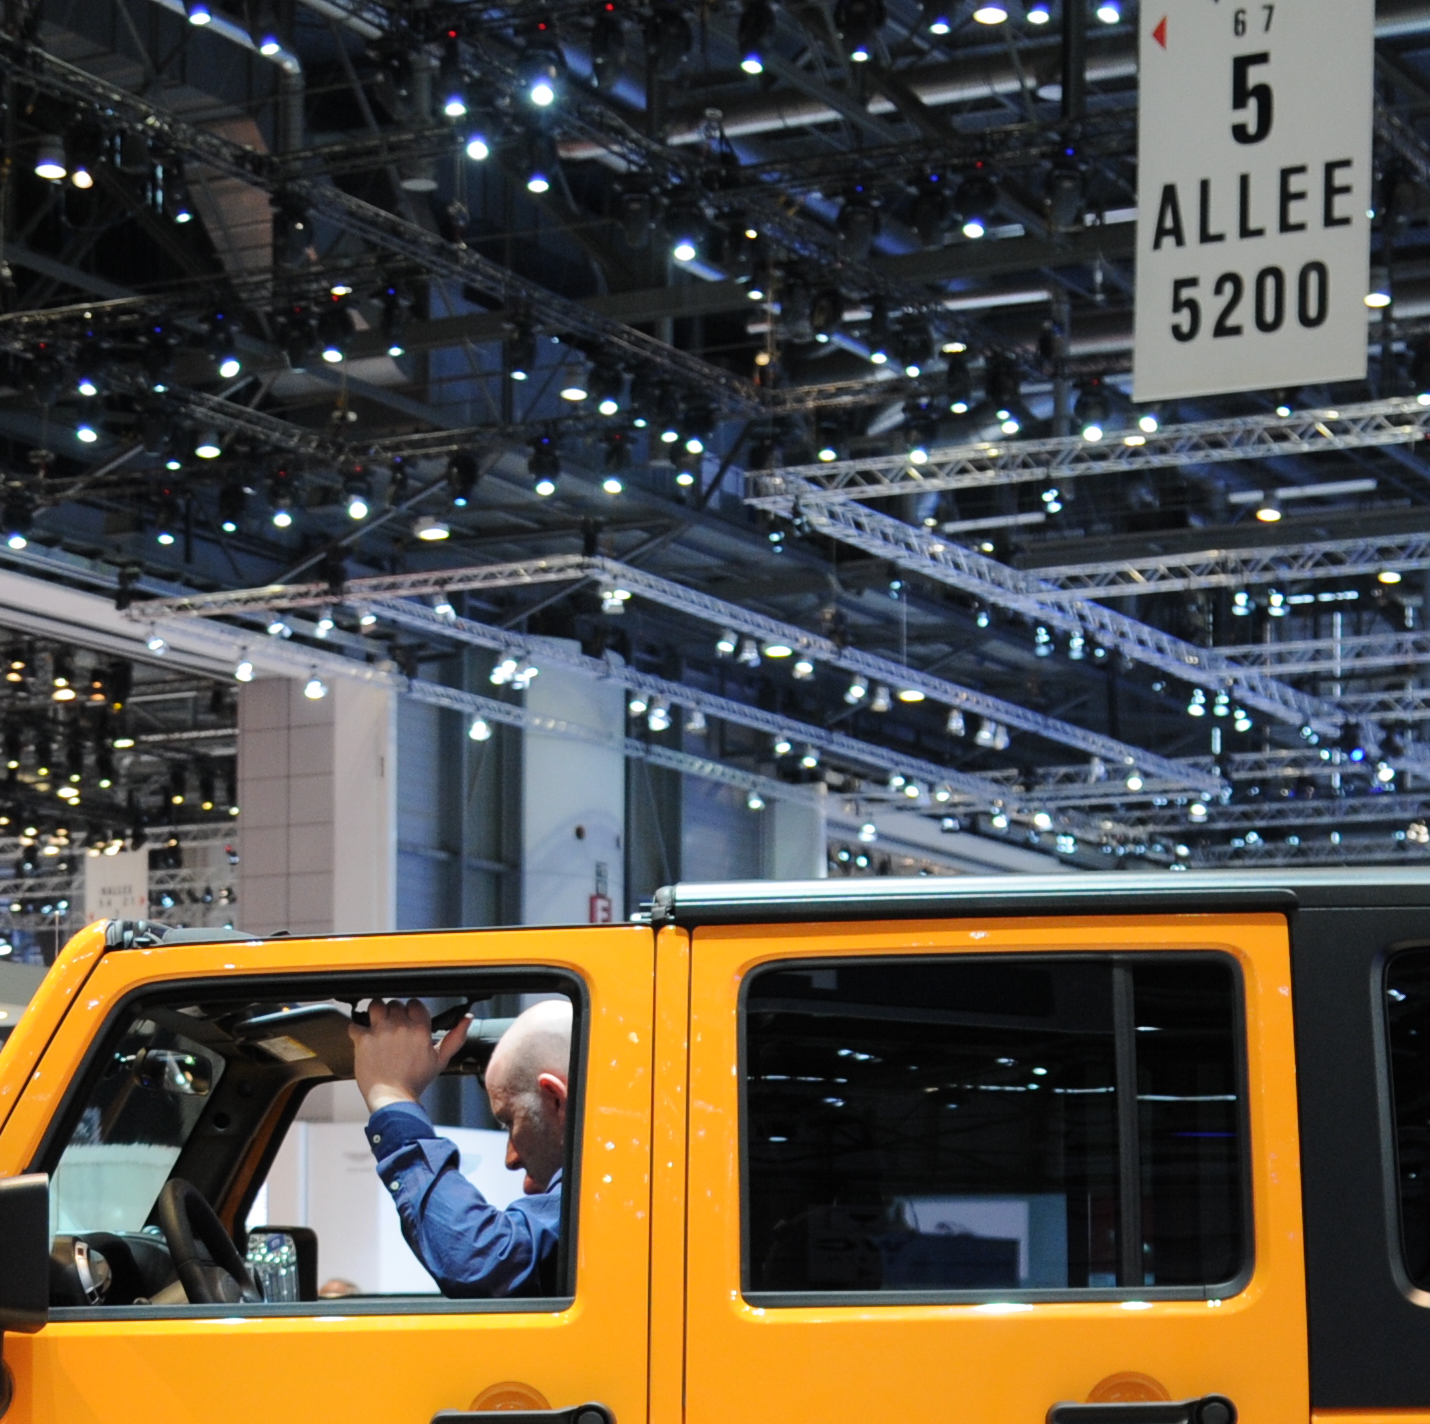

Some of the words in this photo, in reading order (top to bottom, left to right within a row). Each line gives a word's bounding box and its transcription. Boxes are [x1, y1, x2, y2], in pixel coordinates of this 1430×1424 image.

[1231, 51, 1275, 146] 5
[1152, 158, 1353, 251] ALLEE
[1170, 260, 1329, 343] 5200
